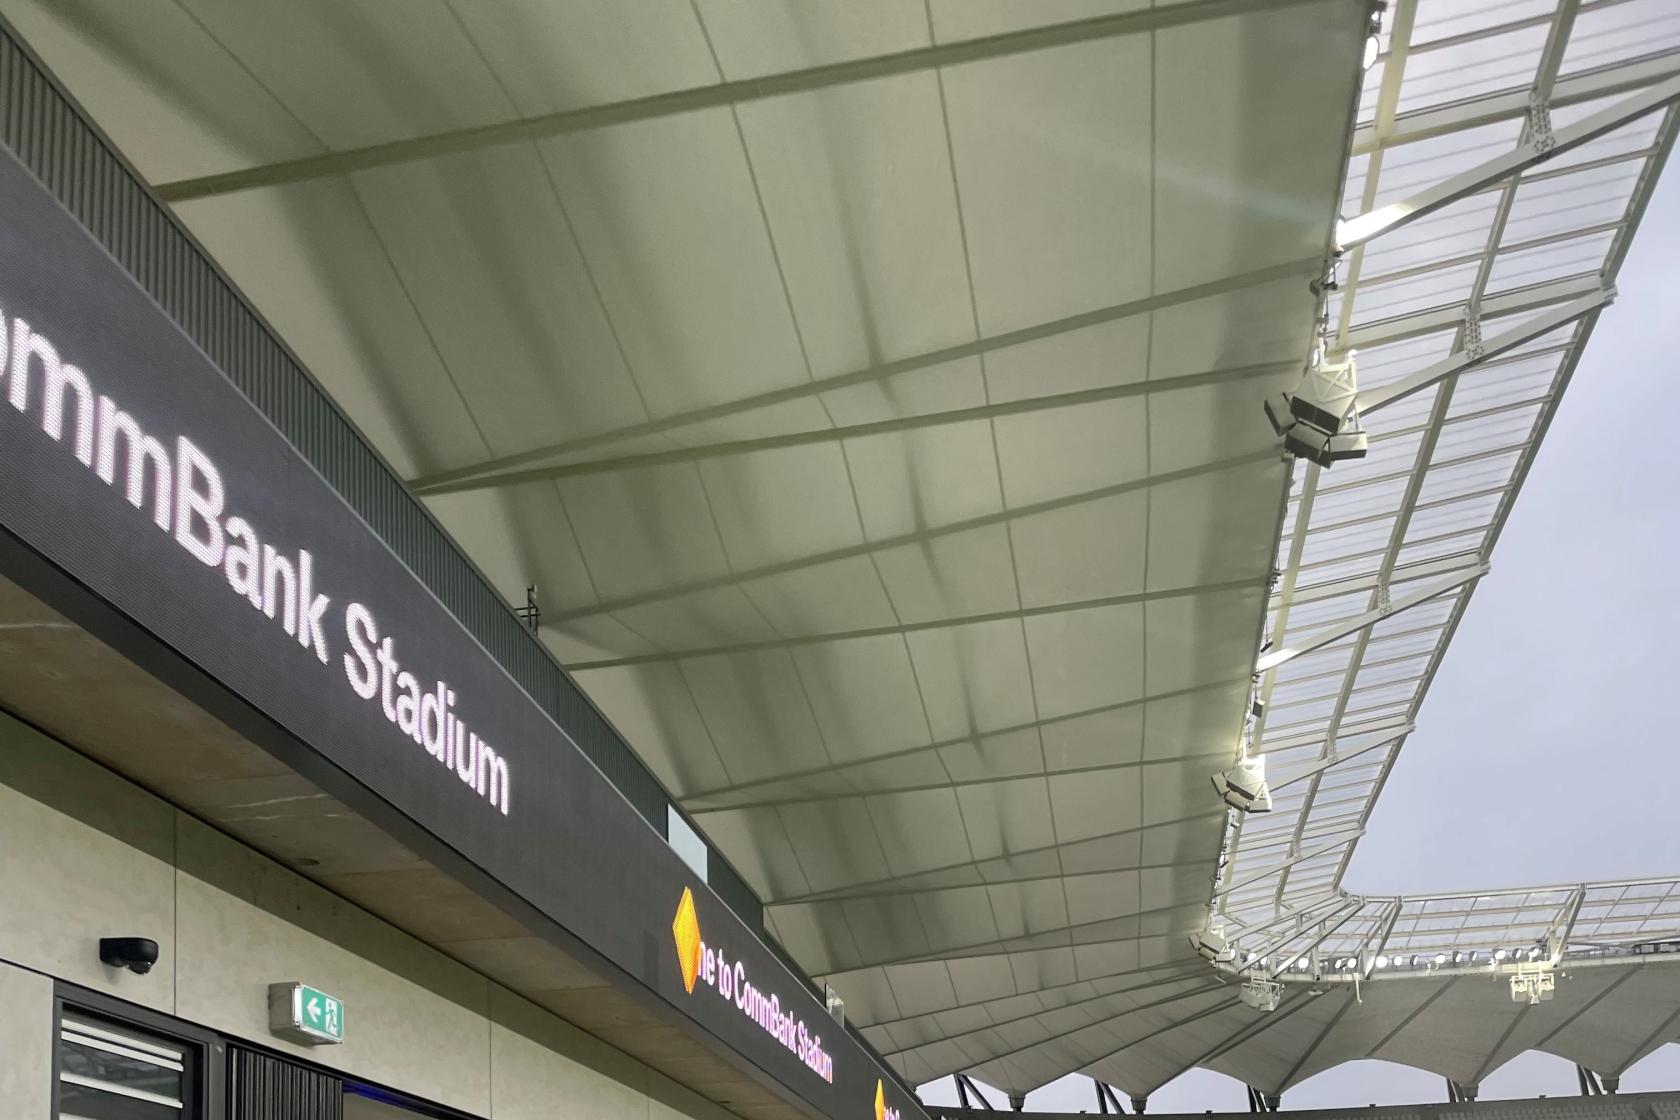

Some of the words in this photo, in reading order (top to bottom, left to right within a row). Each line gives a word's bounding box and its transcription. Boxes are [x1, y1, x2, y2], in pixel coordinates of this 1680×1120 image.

[0, 309, 328, 665] mmBank
[343, 602, 510, 816] Stadium
[717, 948, 732, 999] to
[734, 961, 797, 1055] CommBank
[798, 1020, 833, 1084] Stadium
